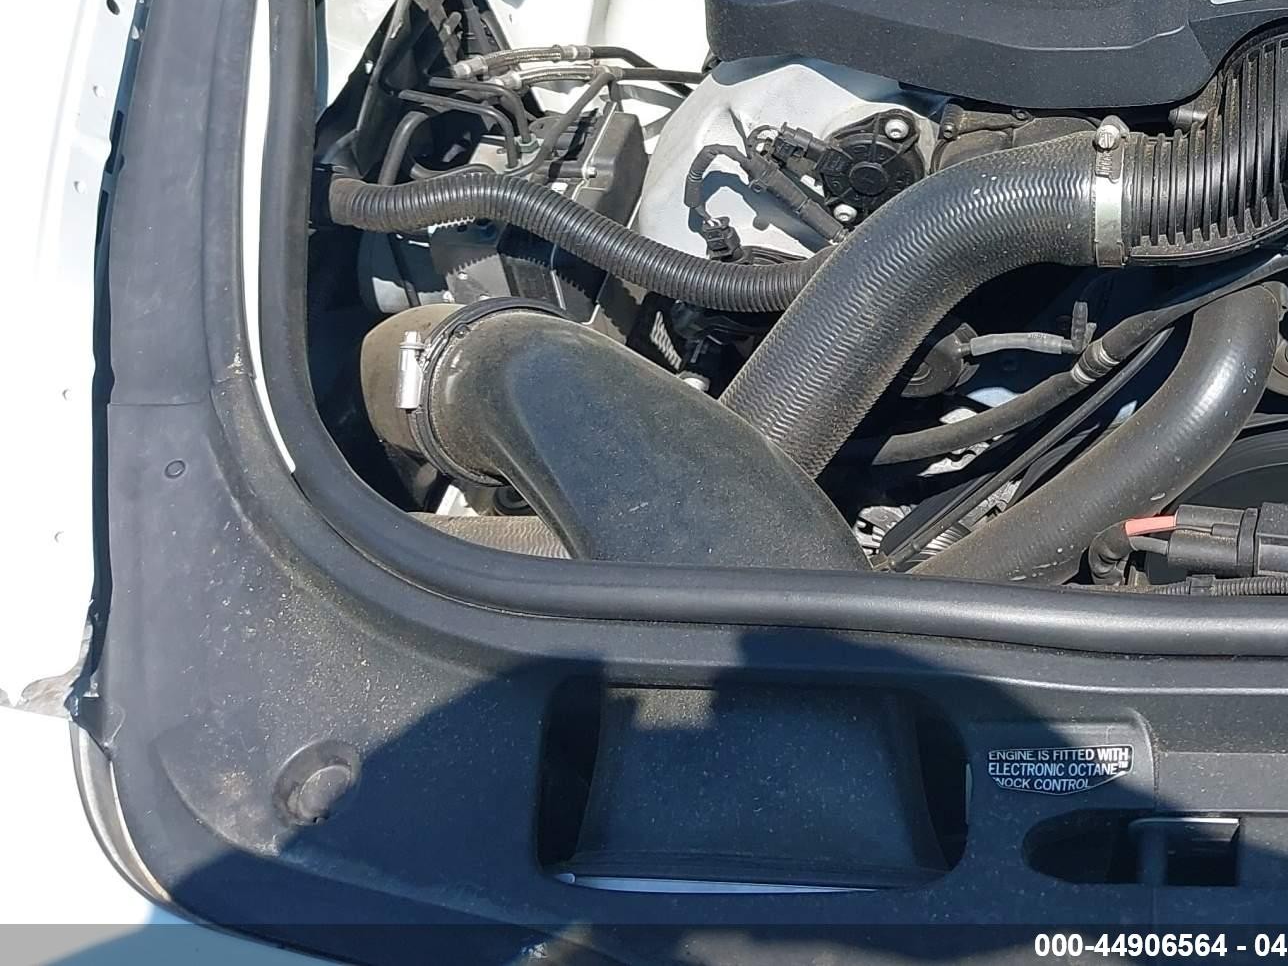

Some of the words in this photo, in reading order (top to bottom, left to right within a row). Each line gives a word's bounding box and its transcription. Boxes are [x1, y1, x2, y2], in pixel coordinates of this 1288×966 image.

[988, 750, 1035, 762] ENGINE
[1038, 750, 1050, 761] IS
[1053, 748, 1095, 761] FITTED
[1096, 747, 1128, 761] WITH
[988, 762, 1065, 777] ELECTRONIC
[992, 777, 1032, 790] NOCK
[1034, 778, 1090, 792] CONTROL
